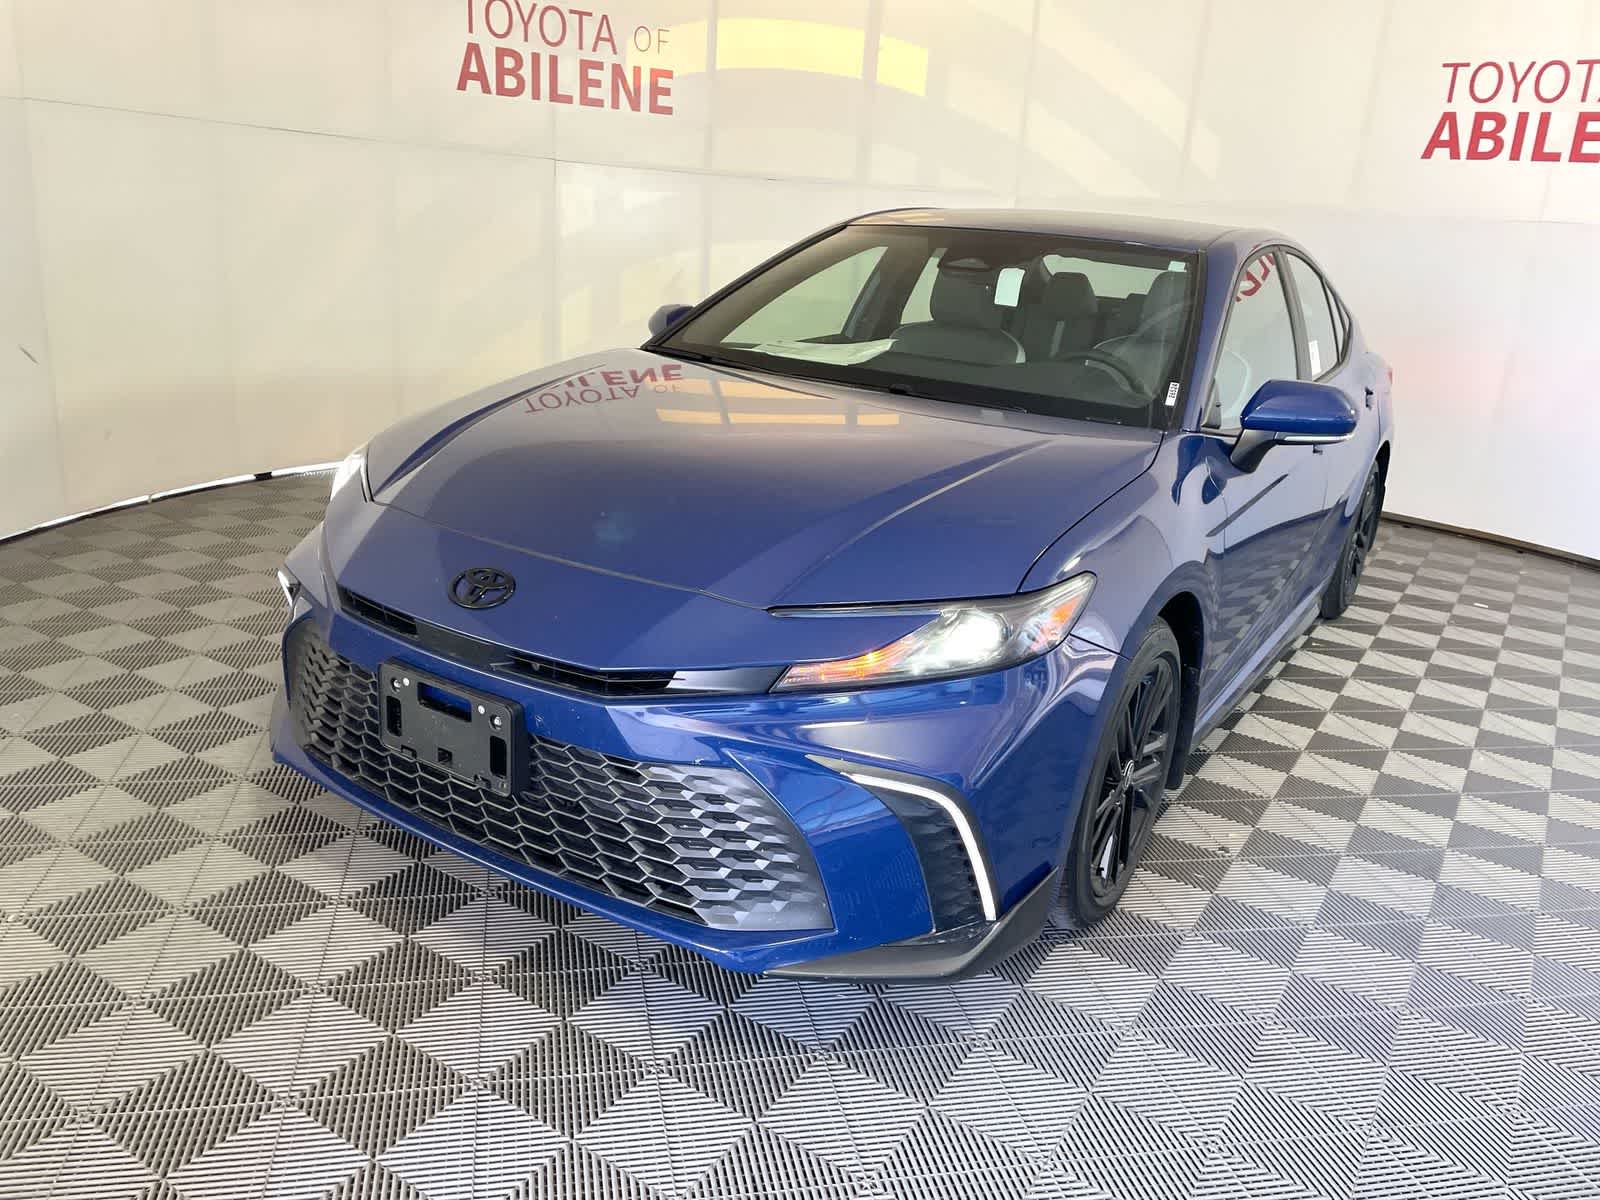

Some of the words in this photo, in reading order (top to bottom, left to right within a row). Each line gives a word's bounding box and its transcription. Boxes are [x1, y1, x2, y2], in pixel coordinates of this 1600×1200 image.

[633, 25, 670, 54] OF
[456, 42, 674, 116] ABILENE
[1442, 59, 1600, 104] TOYOT
[1420, 111, 1600, 163] ABILE
